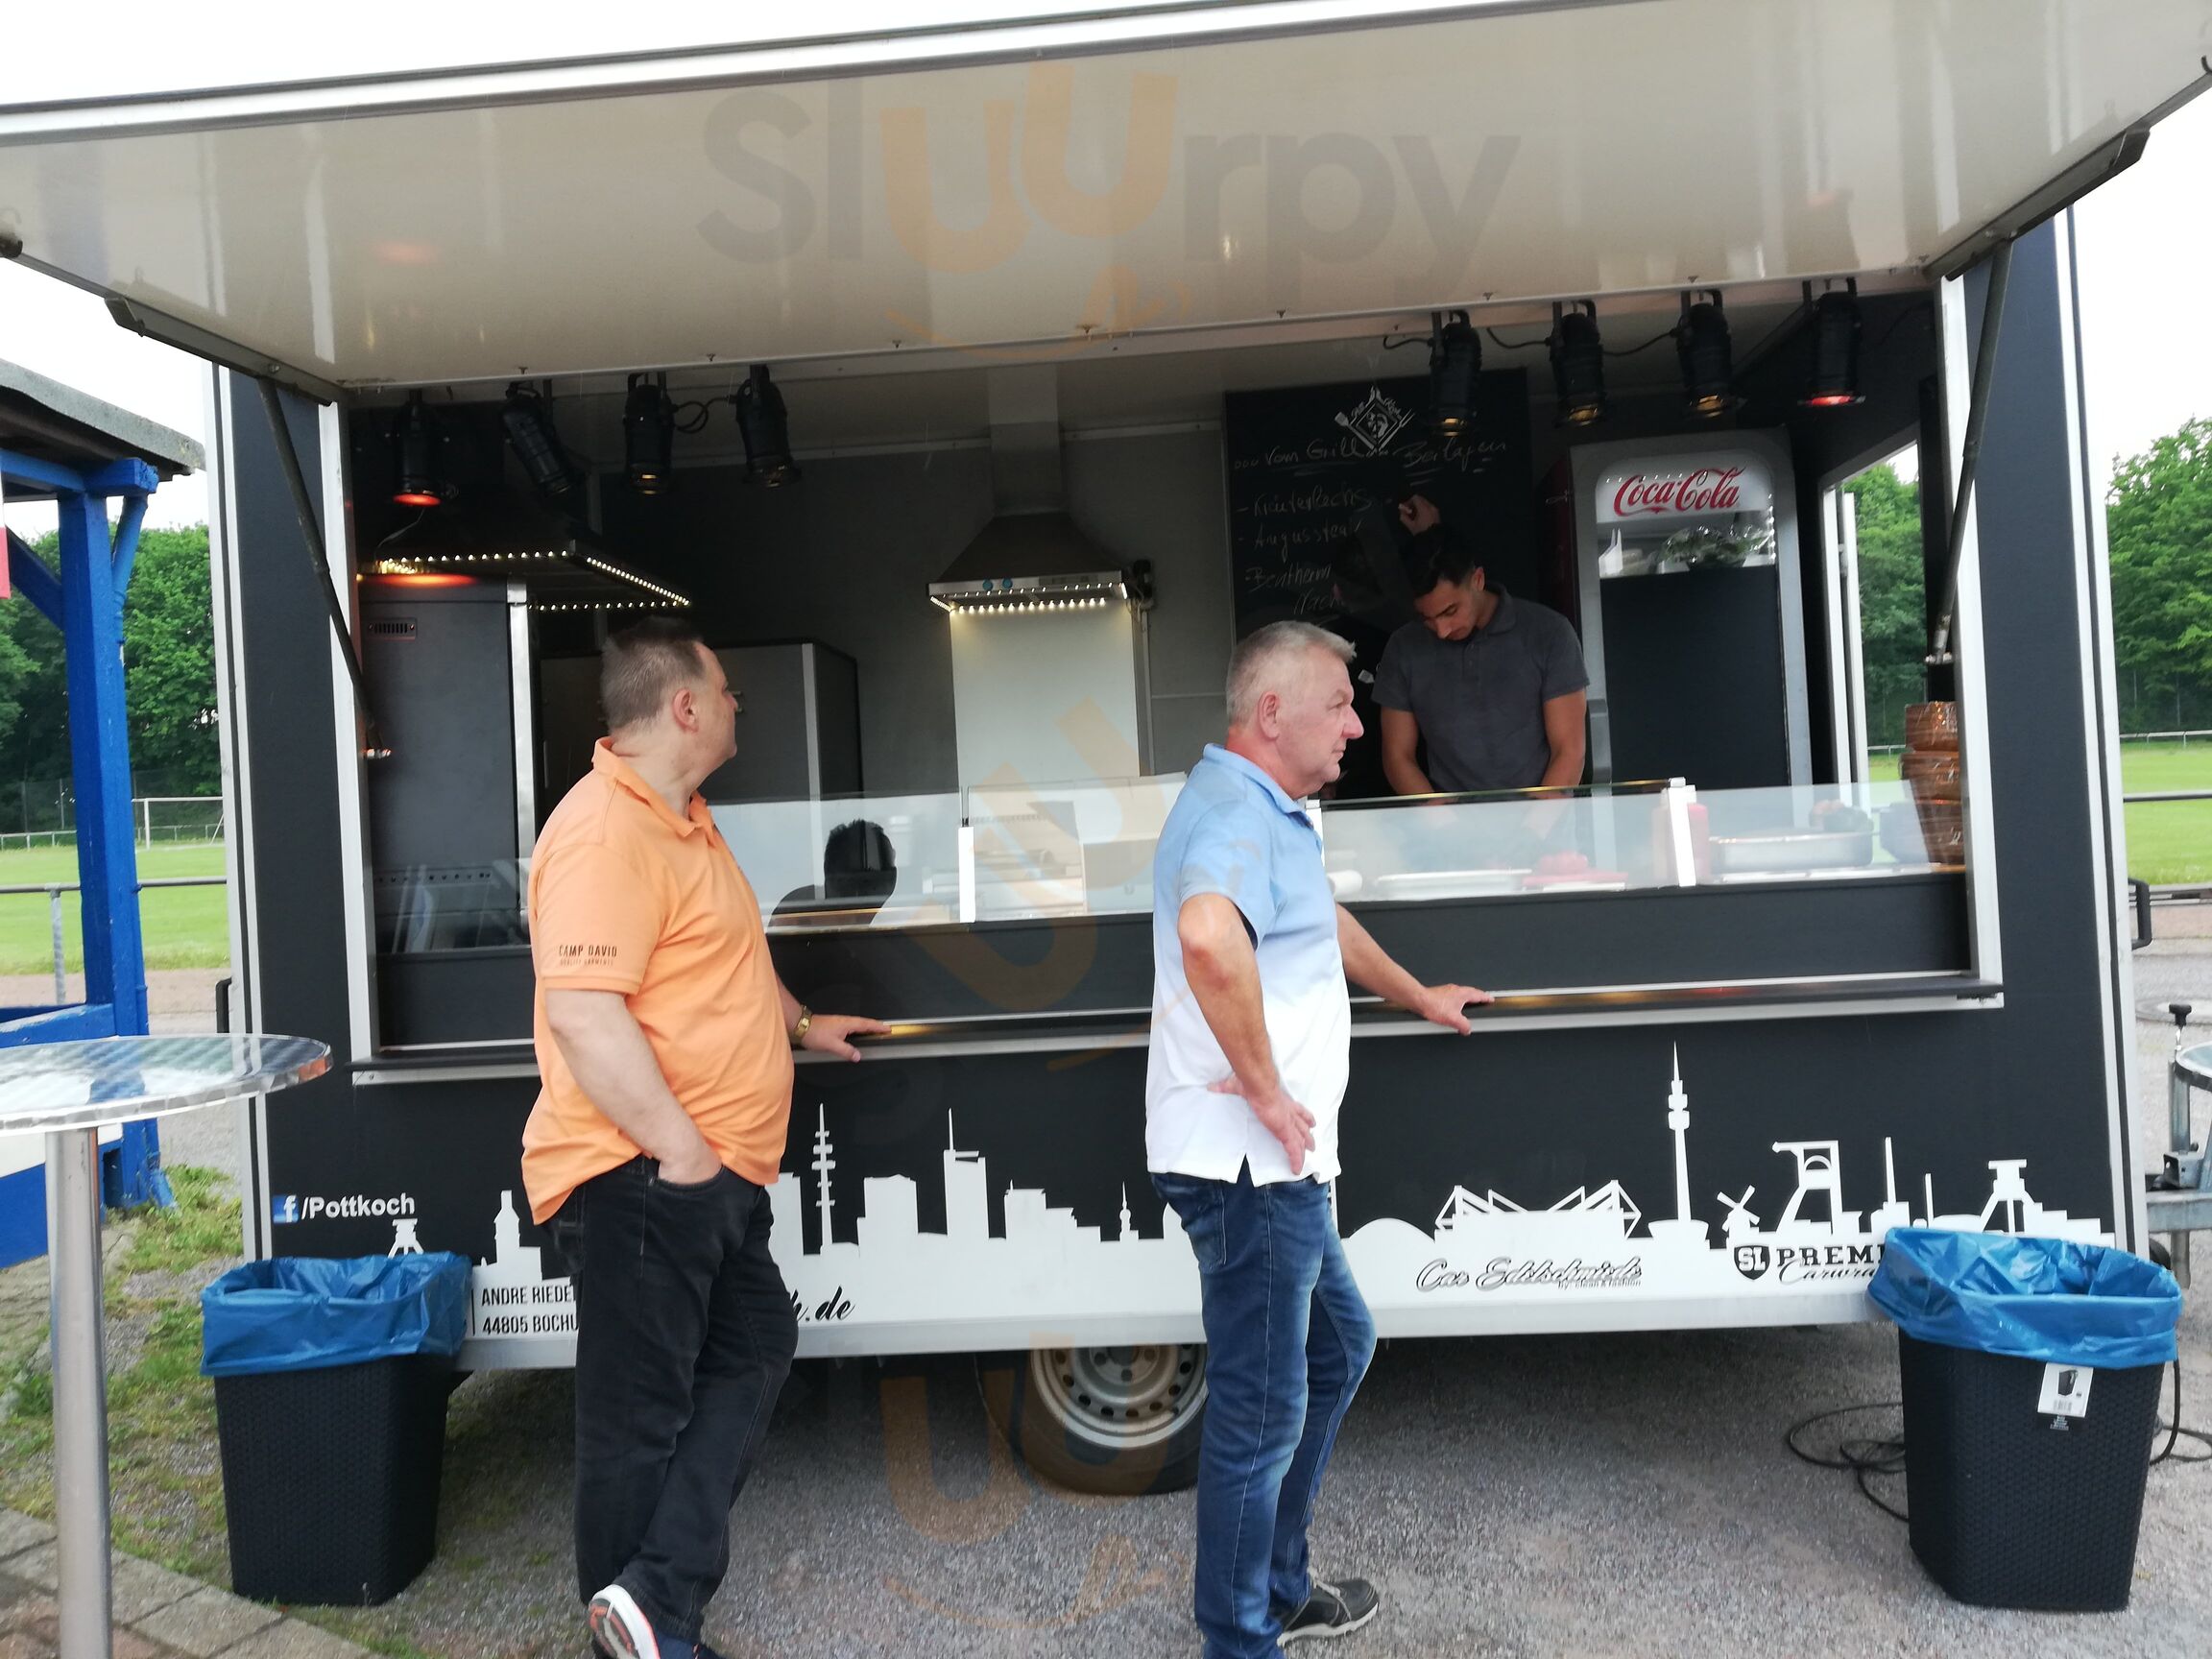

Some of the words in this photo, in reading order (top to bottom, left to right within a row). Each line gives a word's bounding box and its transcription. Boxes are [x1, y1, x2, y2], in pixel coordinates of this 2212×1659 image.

[559, 944, 583, 957] CAMP
[588, 944, 617, 957] DAVID
[1739, 1246, 1767, 1272] SL
[1776, 1243, 1885, 1267] PREMI
[1778, 1258, 1875, 1286] Carava
[481, 1286, 527, 1306] ANDRE
[532, 1285, 576, 1304] RIEDE
[789, 1285, 856, 1322] h.de
[483, 1314, 528, 1334] 44805
[533, 1313, 578, 1333] BOCHU
